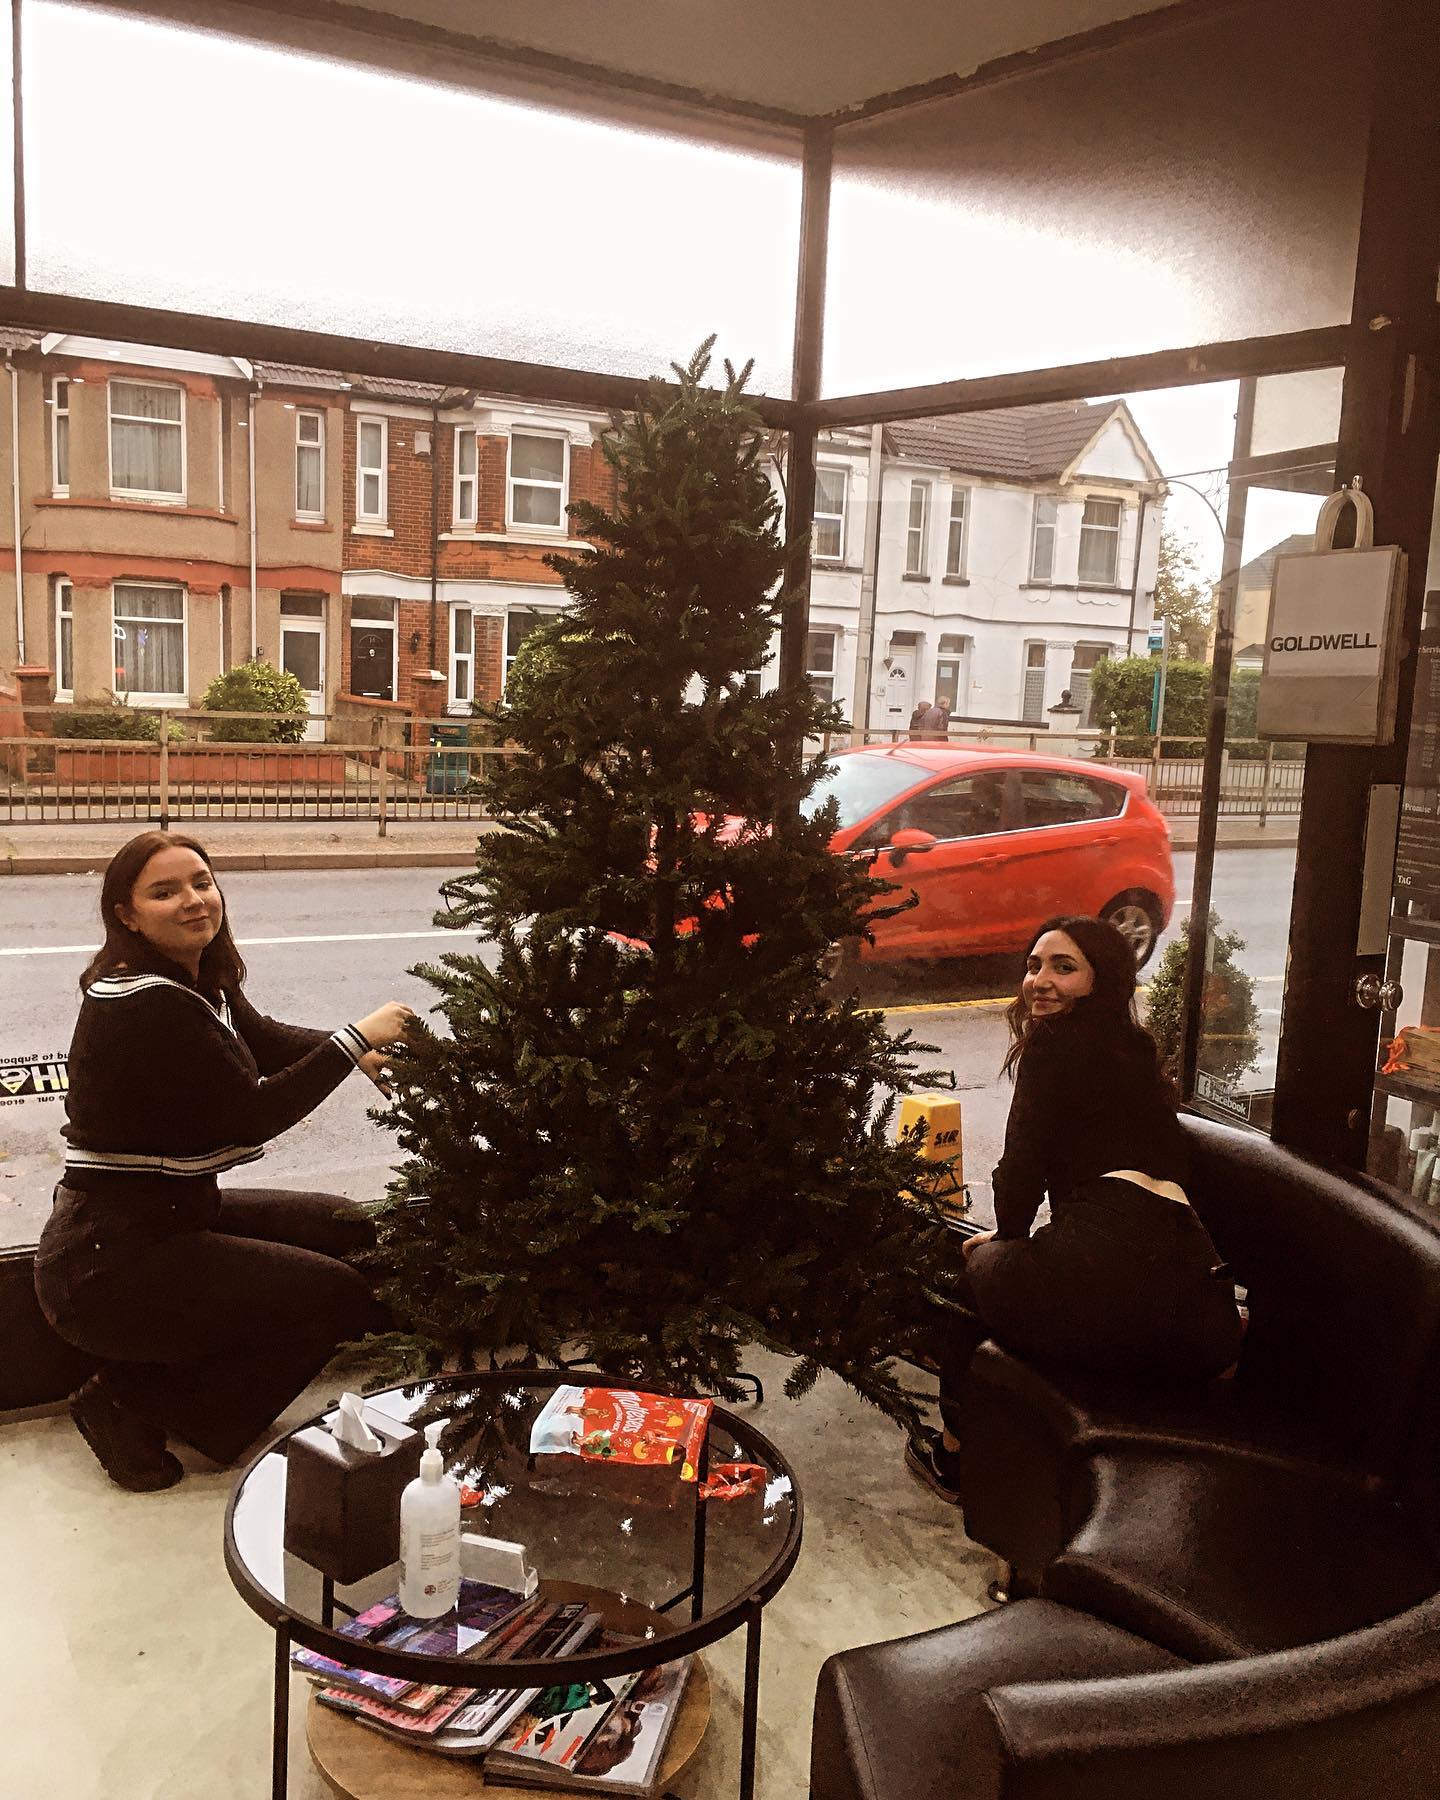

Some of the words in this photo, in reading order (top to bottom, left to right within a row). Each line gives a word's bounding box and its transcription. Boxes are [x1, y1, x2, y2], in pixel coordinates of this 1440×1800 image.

[1270, 633, 1378, 652] GOLDWELL
[1404, 803, 1432, 814] Promise
[1212, 1090, 1246, 1114] facebook
[607, 1391, 649, 1433] Maltesers
